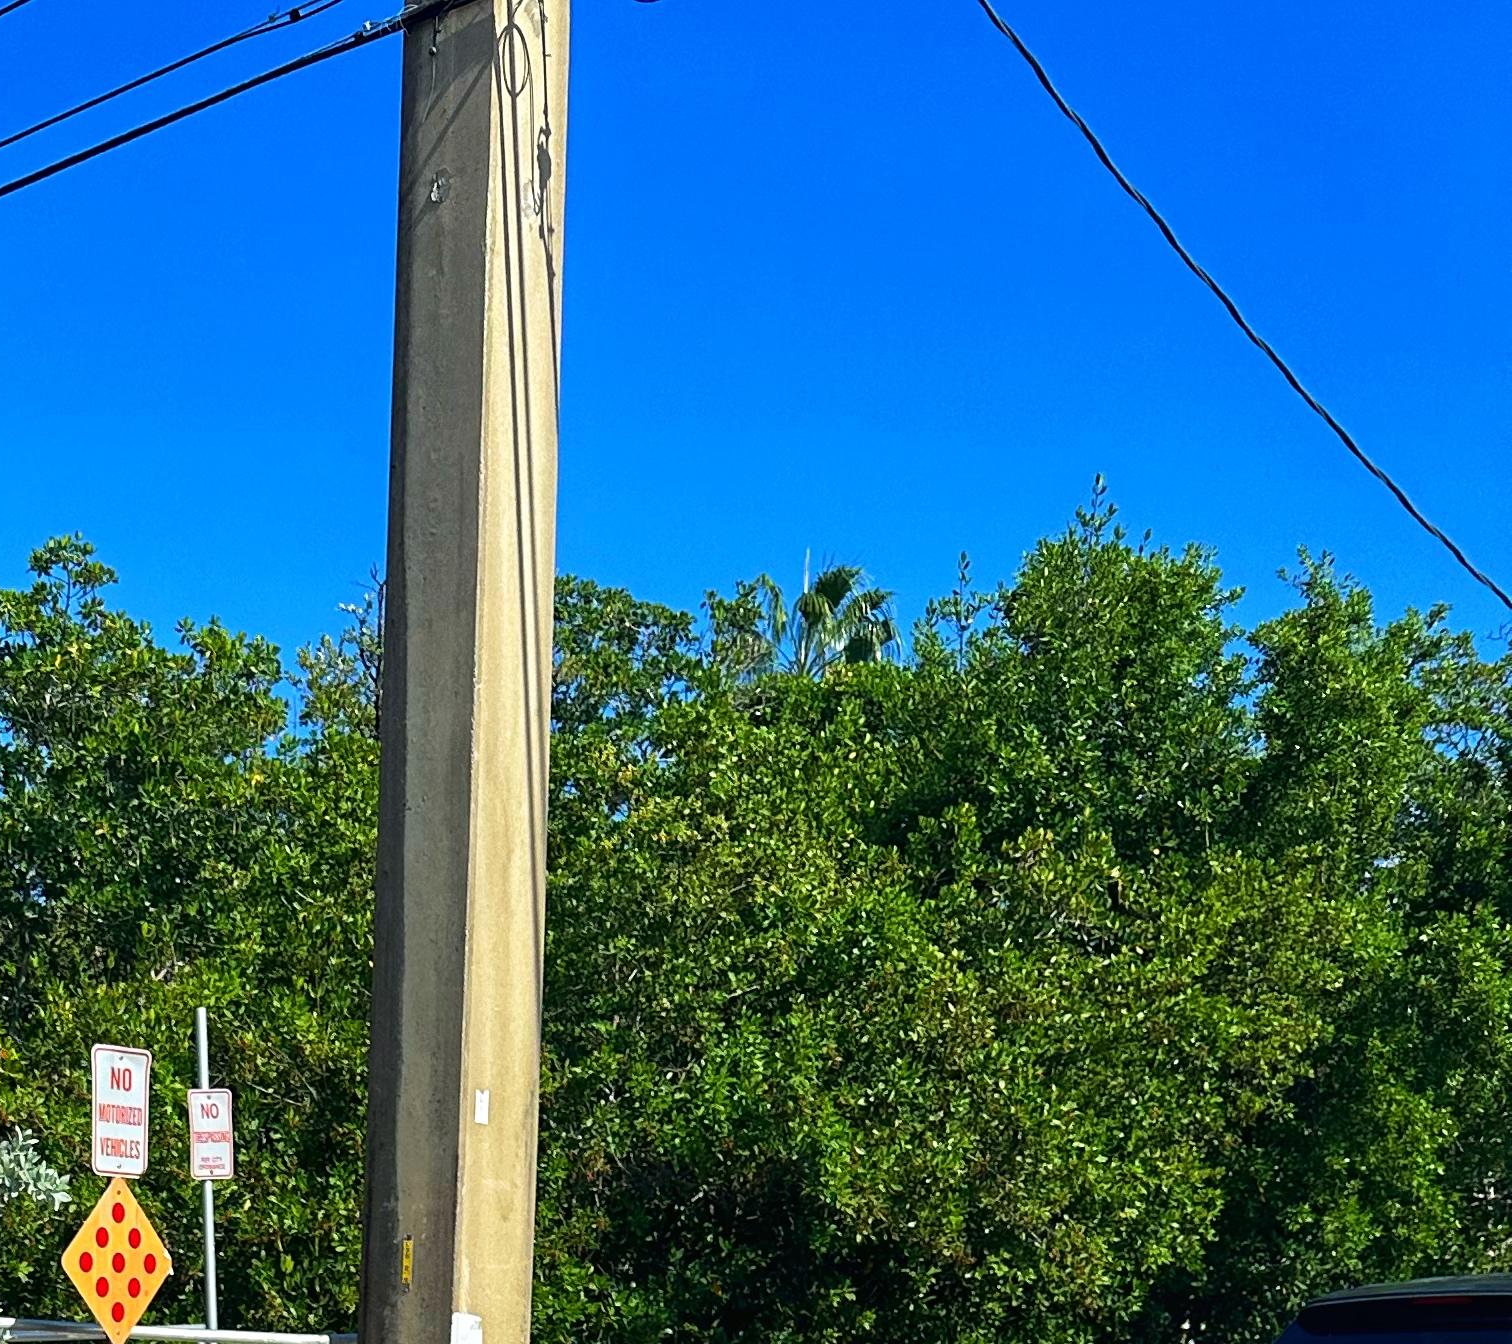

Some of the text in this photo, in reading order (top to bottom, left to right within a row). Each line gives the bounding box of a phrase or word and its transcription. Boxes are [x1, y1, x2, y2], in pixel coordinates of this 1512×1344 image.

[110, 1066, 132, 1092] NO
[98, 1102, 143, 1127] MOTORIZED
[200, 1103, 219, 1119] NO
[100, 1136, 141, 1160] VEHICLES
